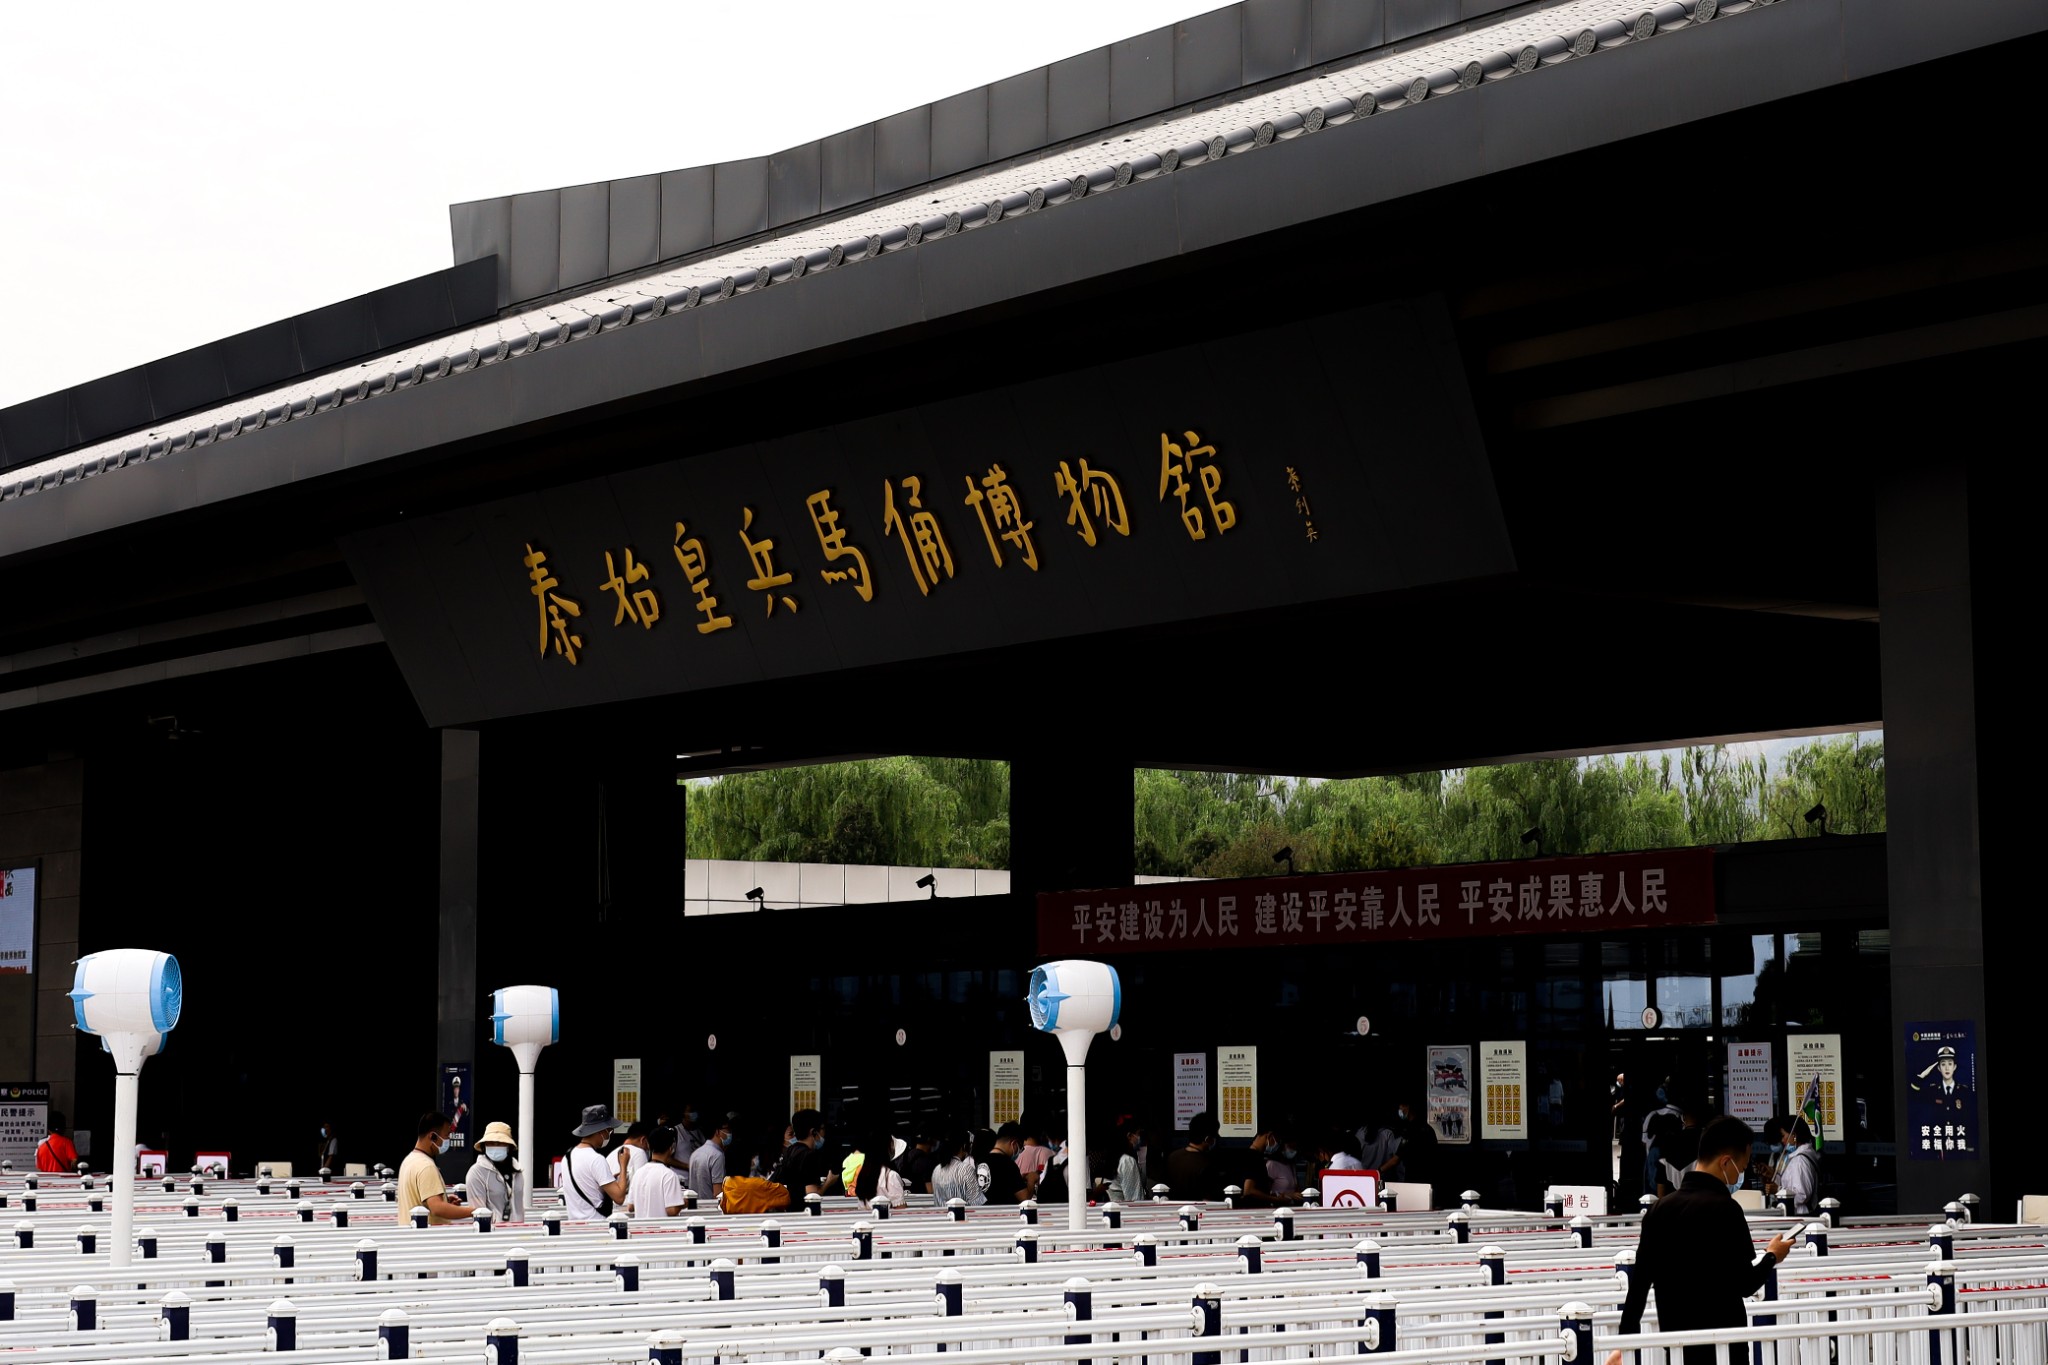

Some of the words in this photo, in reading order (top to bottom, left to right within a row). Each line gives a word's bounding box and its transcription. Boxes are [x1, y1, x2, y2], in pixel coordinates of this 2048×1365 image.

[1072, 896, 1239, 943] 平安建设为人民
[1255, 883, 1441, 934] 建设平安靠人民
[1458, 868, 1668, 924] 平安成果惠人民
[1921, 1125, 1966, 1137] 安全用火
[1921, 1138, 1967, 1151] 幸福你我
[1564, 1194, 1589, 1209] 通告
